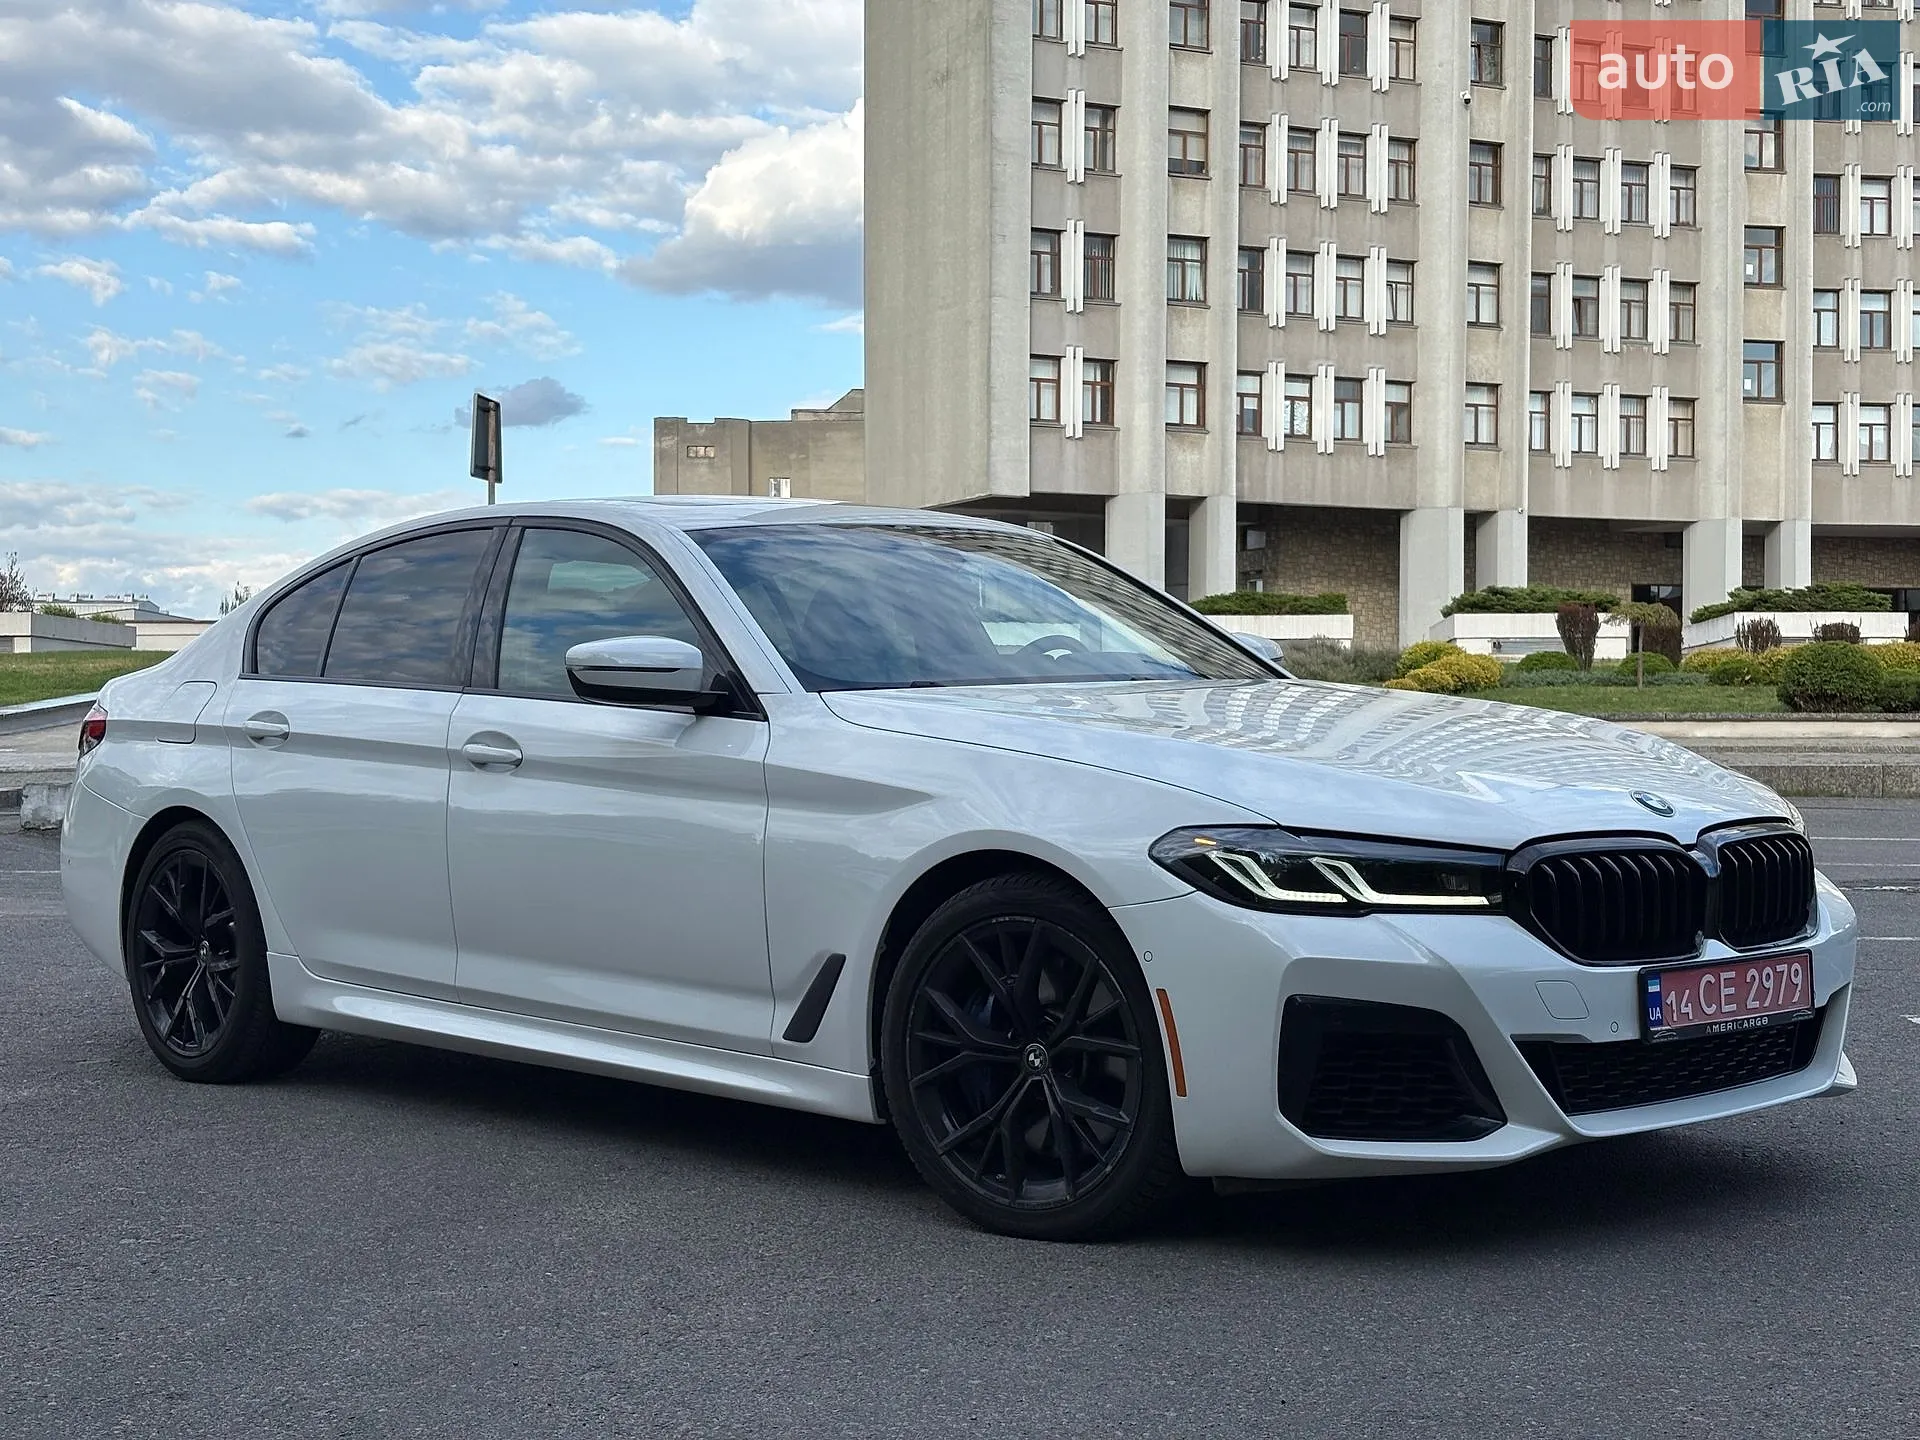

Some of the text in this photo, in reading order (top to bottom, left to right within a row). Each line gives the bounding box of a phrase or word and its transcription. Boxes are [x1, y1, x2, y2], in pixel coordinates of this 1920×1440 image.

[1665, 962, 1803, 1021] 14 CE 2979
[1648, 1006, 1662, 1021] UA
